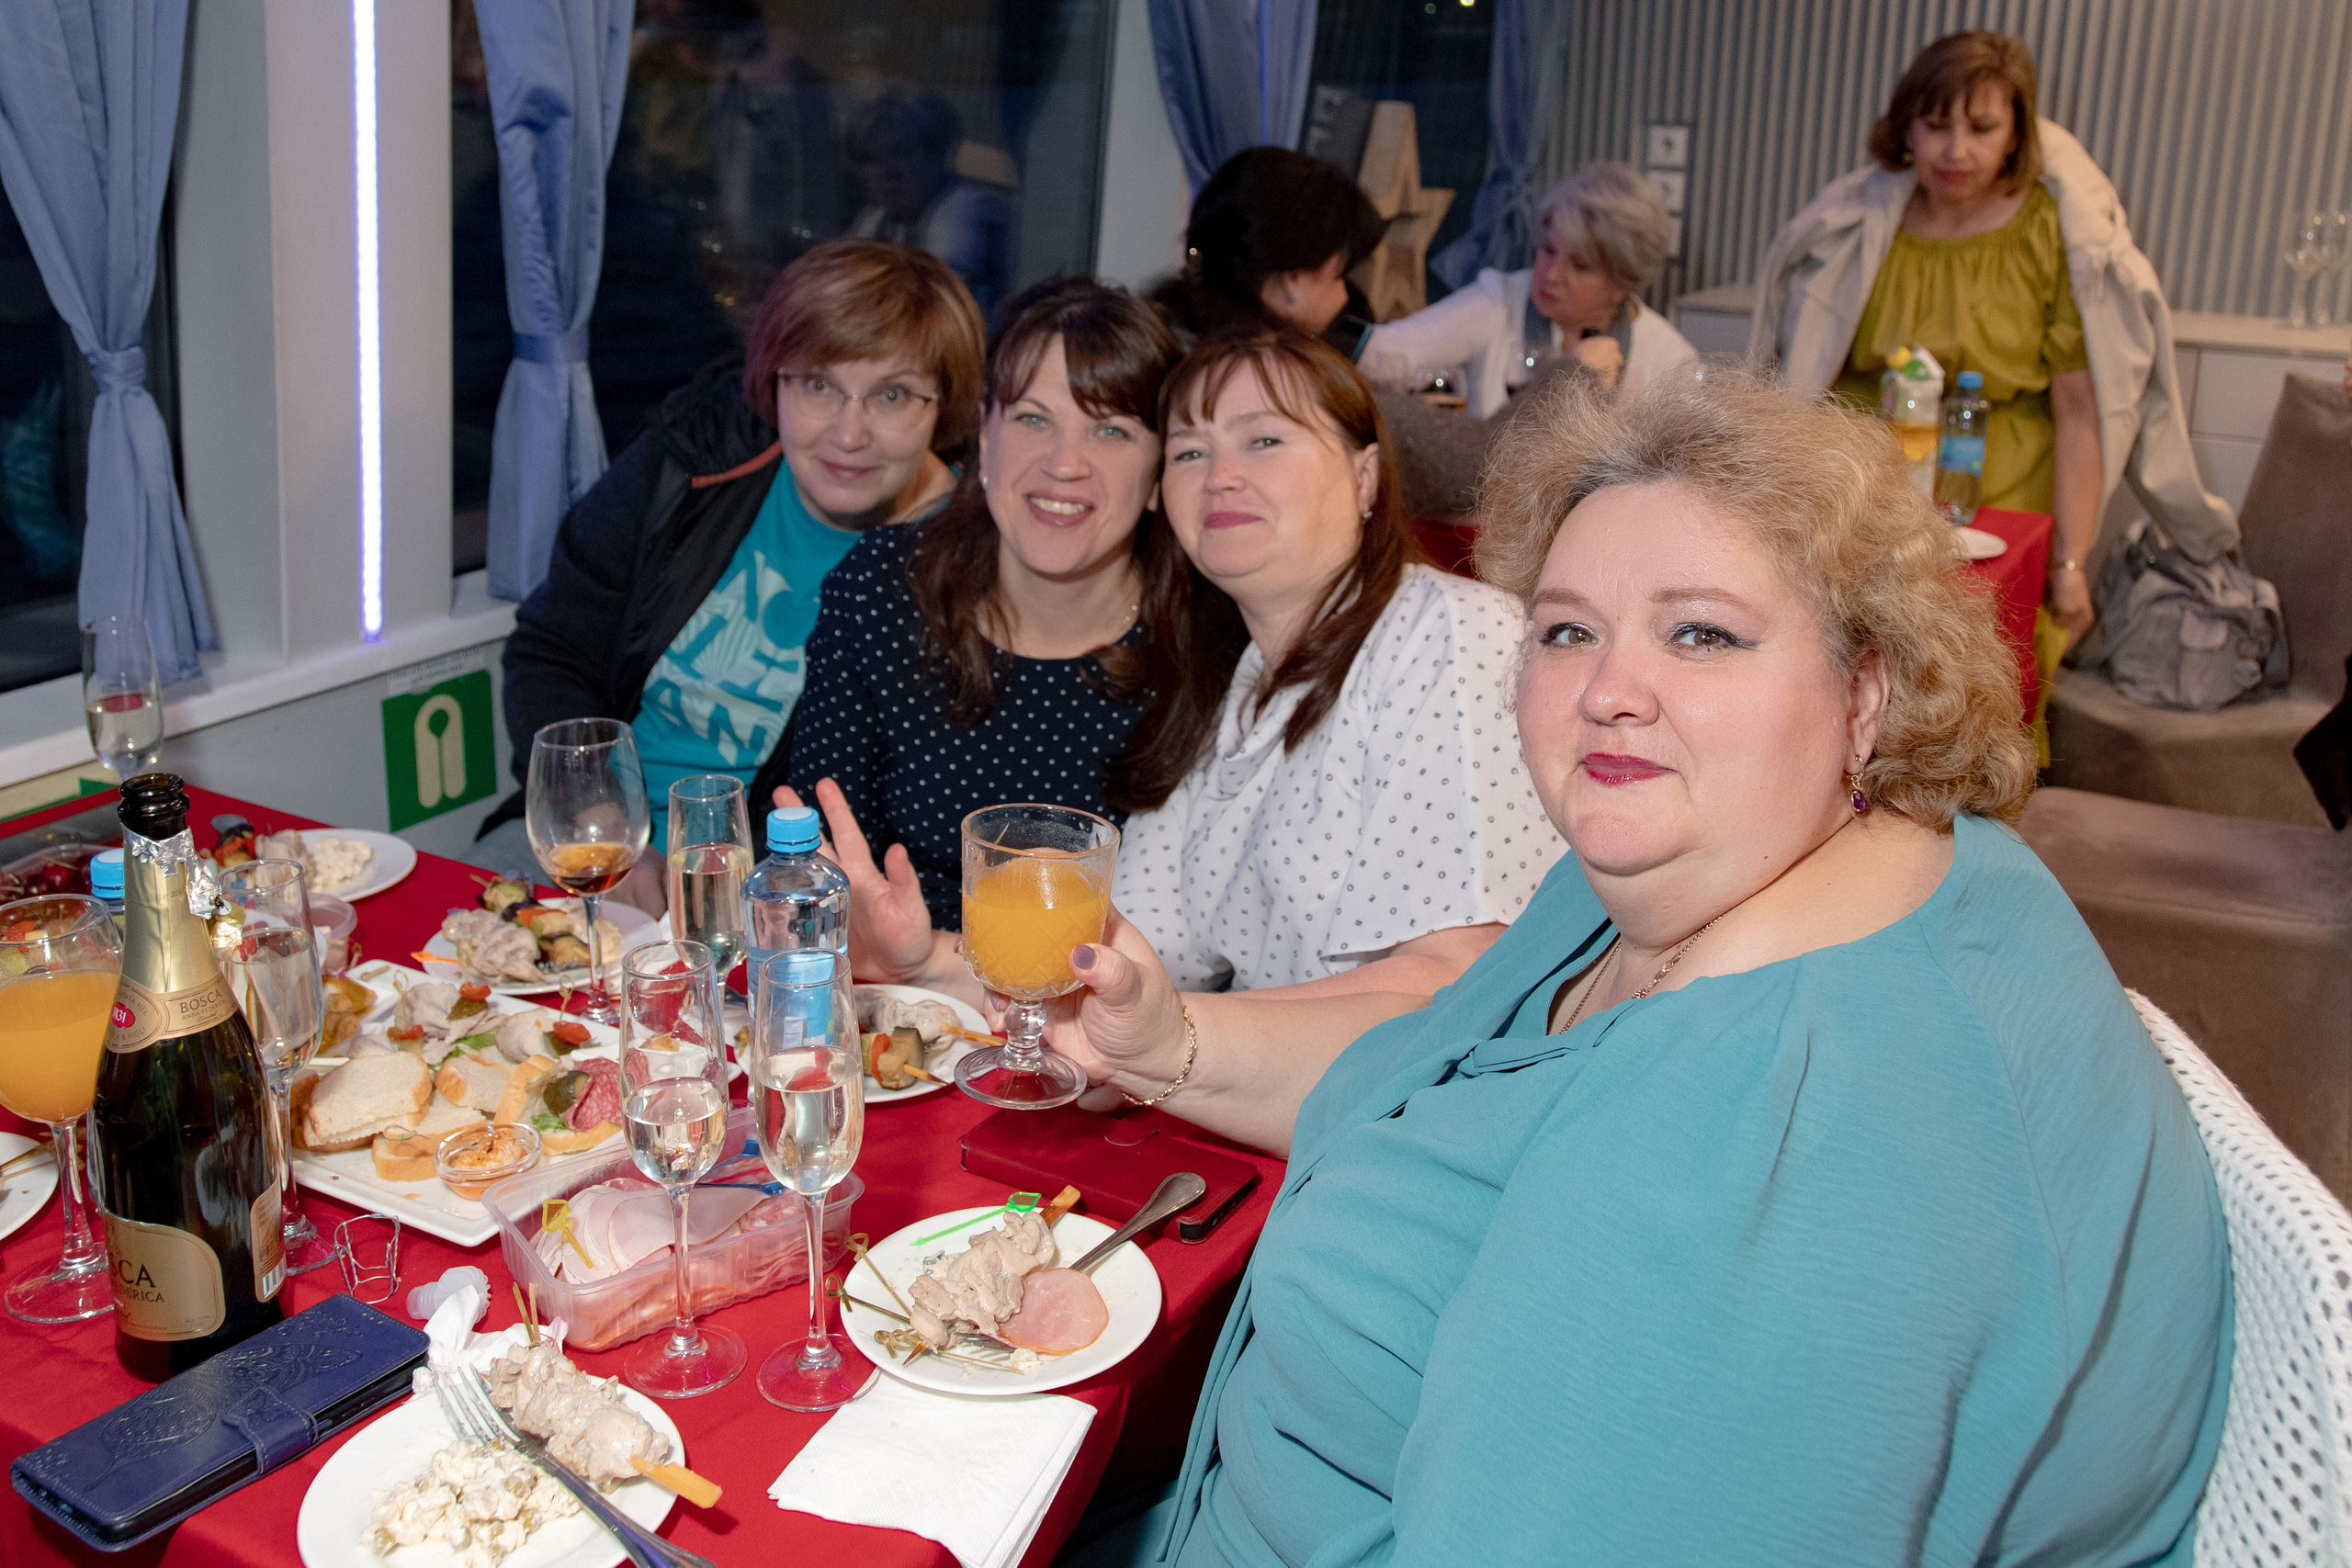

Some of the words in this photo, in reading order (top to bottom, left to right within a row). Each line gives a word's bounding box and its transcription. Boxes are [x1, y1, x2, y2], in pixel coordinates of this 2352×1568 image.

[137, 1001, 149, 1016] NEL
[180, 989, 222, 1014] BOSCA
[181, 1010, 200, 1021] ANNA
[128, 1026, 147, 1040] FIGLI
